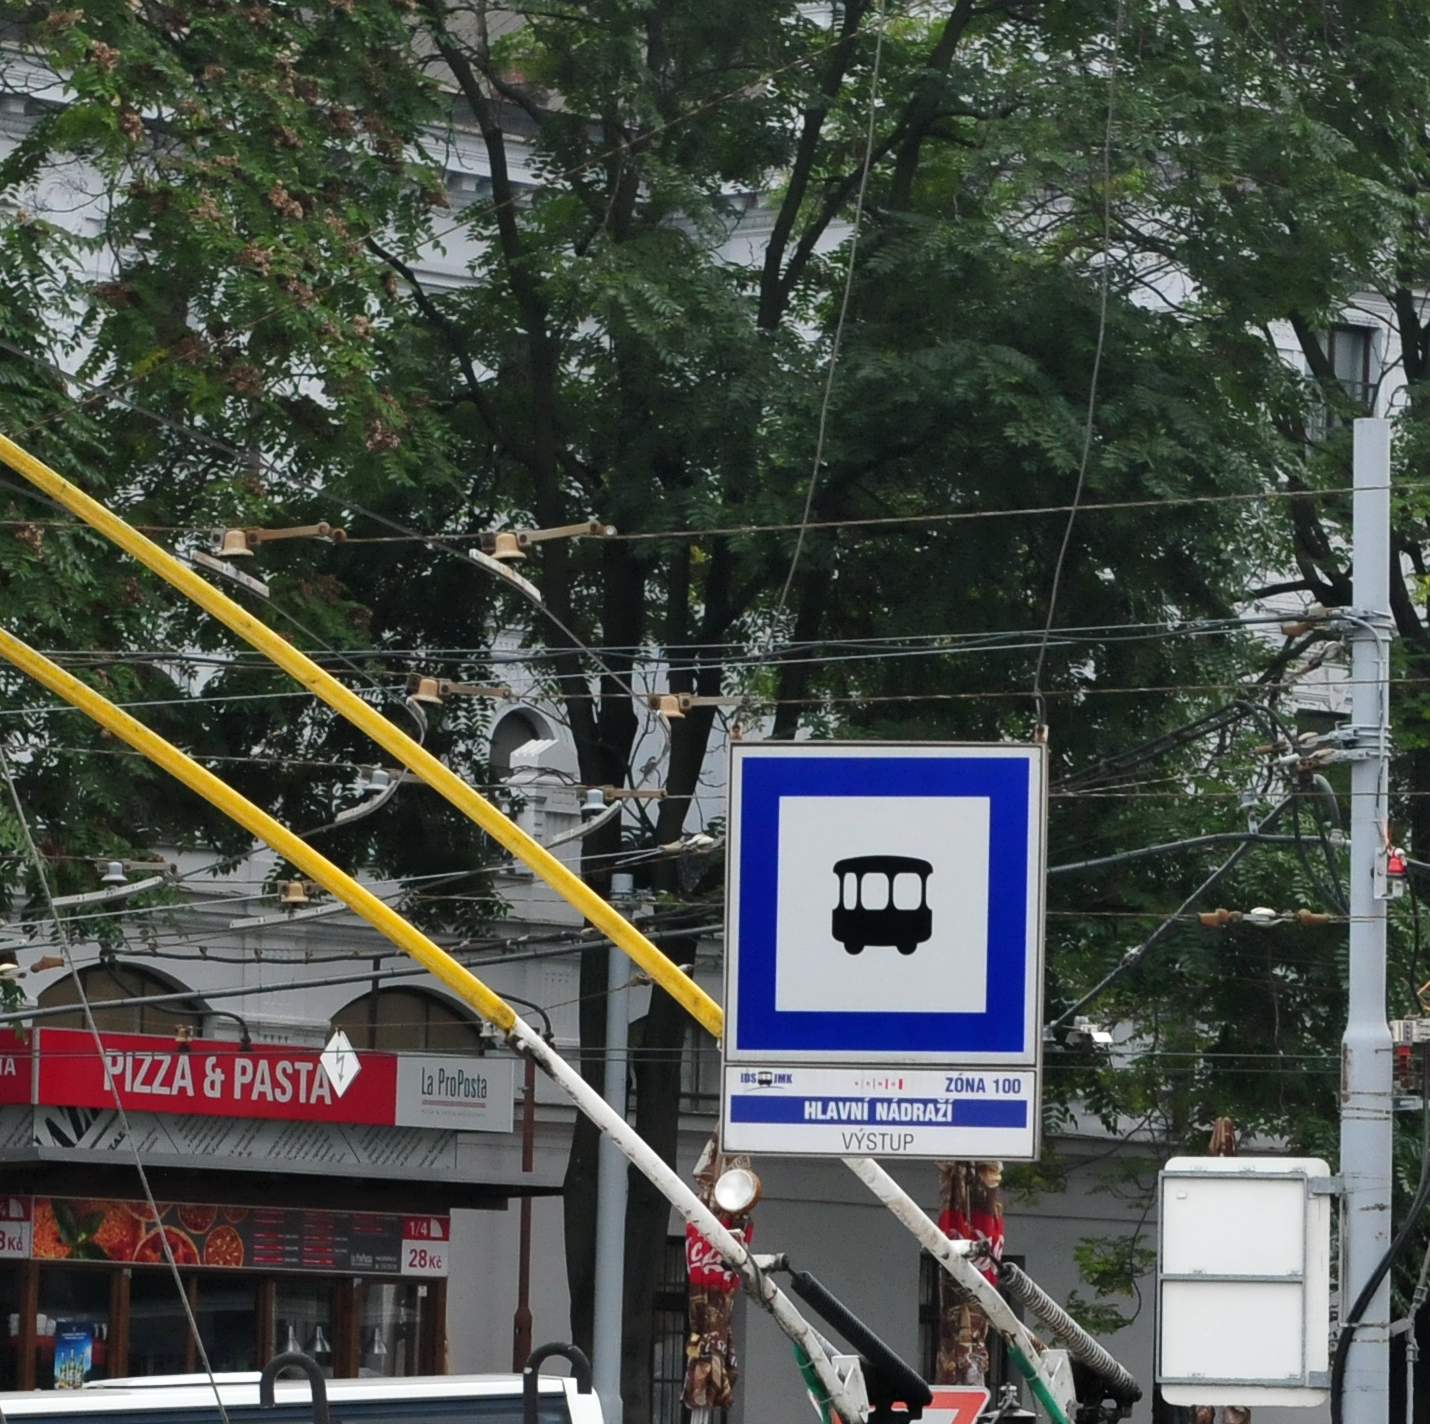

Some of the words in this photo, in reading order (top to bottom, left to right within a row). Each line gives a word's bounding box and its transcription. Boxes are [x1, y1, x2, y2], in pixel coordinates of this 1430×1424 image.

[103, 1048, 194, 1097] PIZZA
[203, 1056, 224, 1098] &
[233, 1058, 332, 1105] PASTA
[421, 1066, 433, 1095] La
[438, 1067, 488, 1099] ProPosta
[740, 1072, 757, 1084] IDS
[945, 1075, 986, 1094] ZÓNA
[993, 1078, 1022, 1094] 100
[804, 1097, 870, 1121] HLAVNÍ
[875, 1099, 954, 1122] NÁDRAŽÍ
[842, 1127, 915, 1151] VÝSTUP
[410, 1221, 428, 1236] 1/4
[408, 1248, 427, 1268] 28
[429, 1255, 442, 1269] Kč
